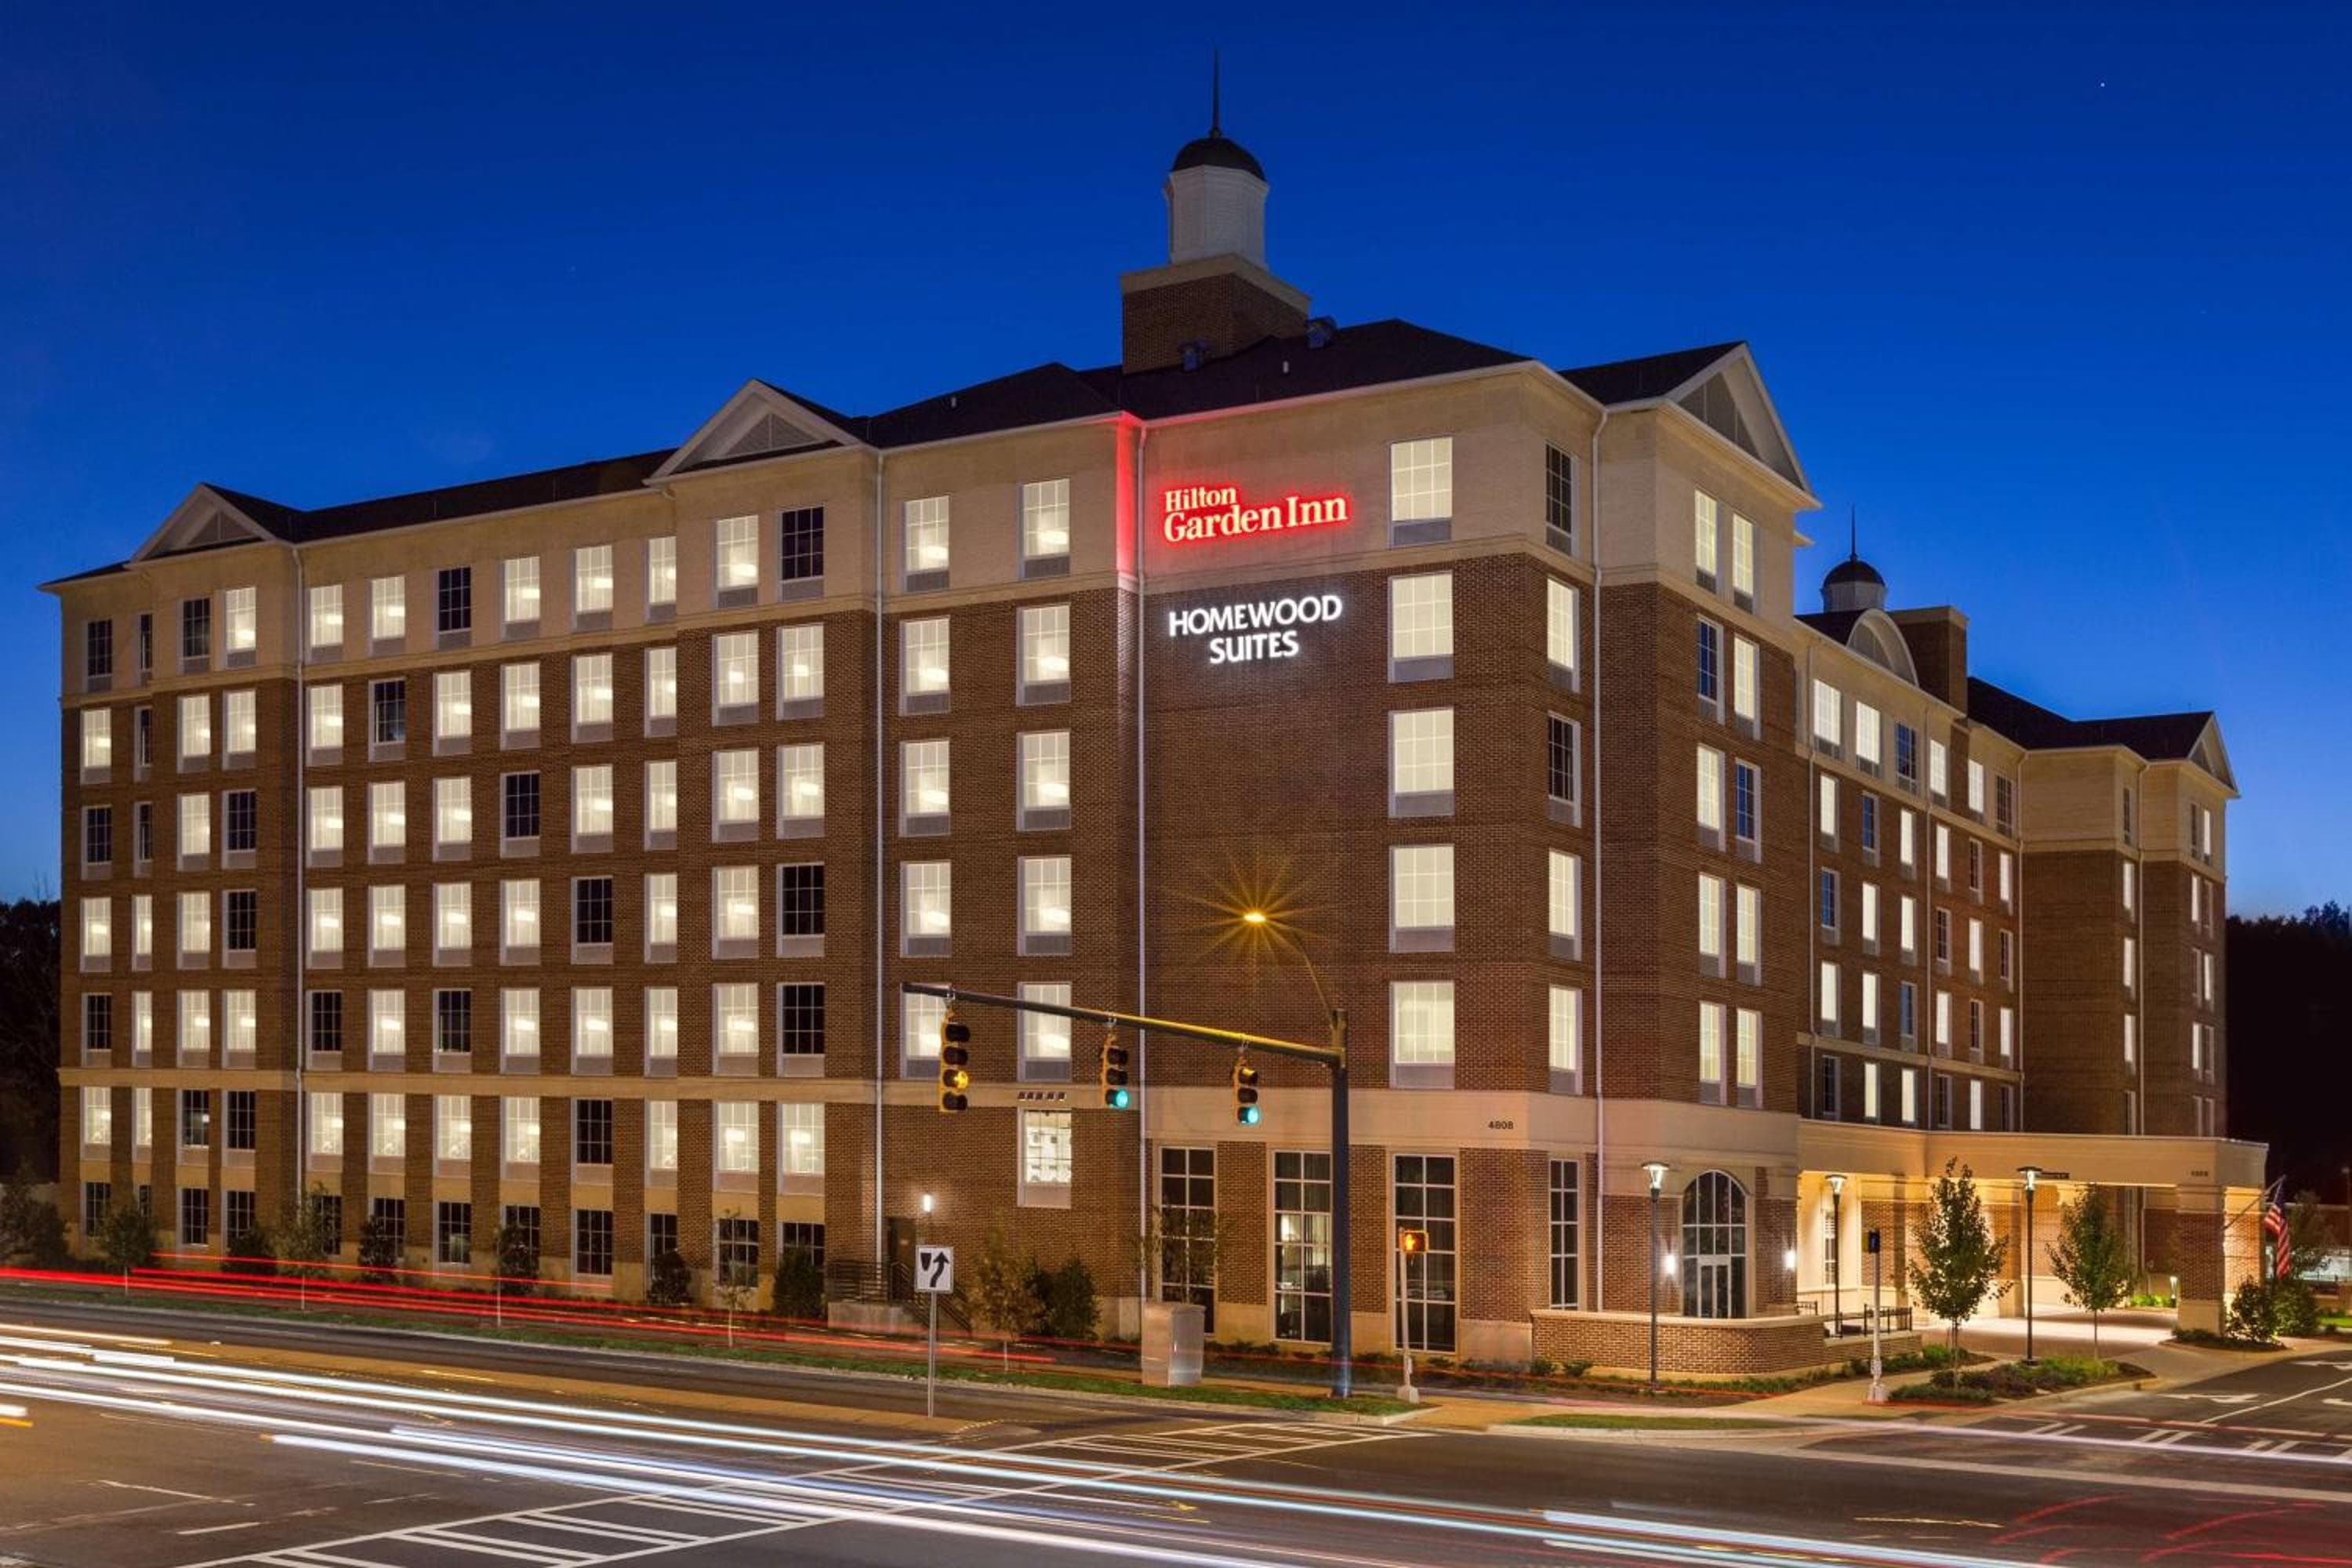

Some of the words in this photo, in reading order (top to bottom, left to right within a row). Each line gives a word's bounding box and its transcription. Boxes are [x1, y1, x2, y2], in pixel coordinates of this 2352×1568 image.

[1163, 503, 1283, 542] Garden
[1287, 495, 1348, 527] Inn
[1165, 487, 1236, 512] Hilton
[1169, 594, 1343, 637] HOMEWOOD
[1209, 630, 1299, 664] SUITES
